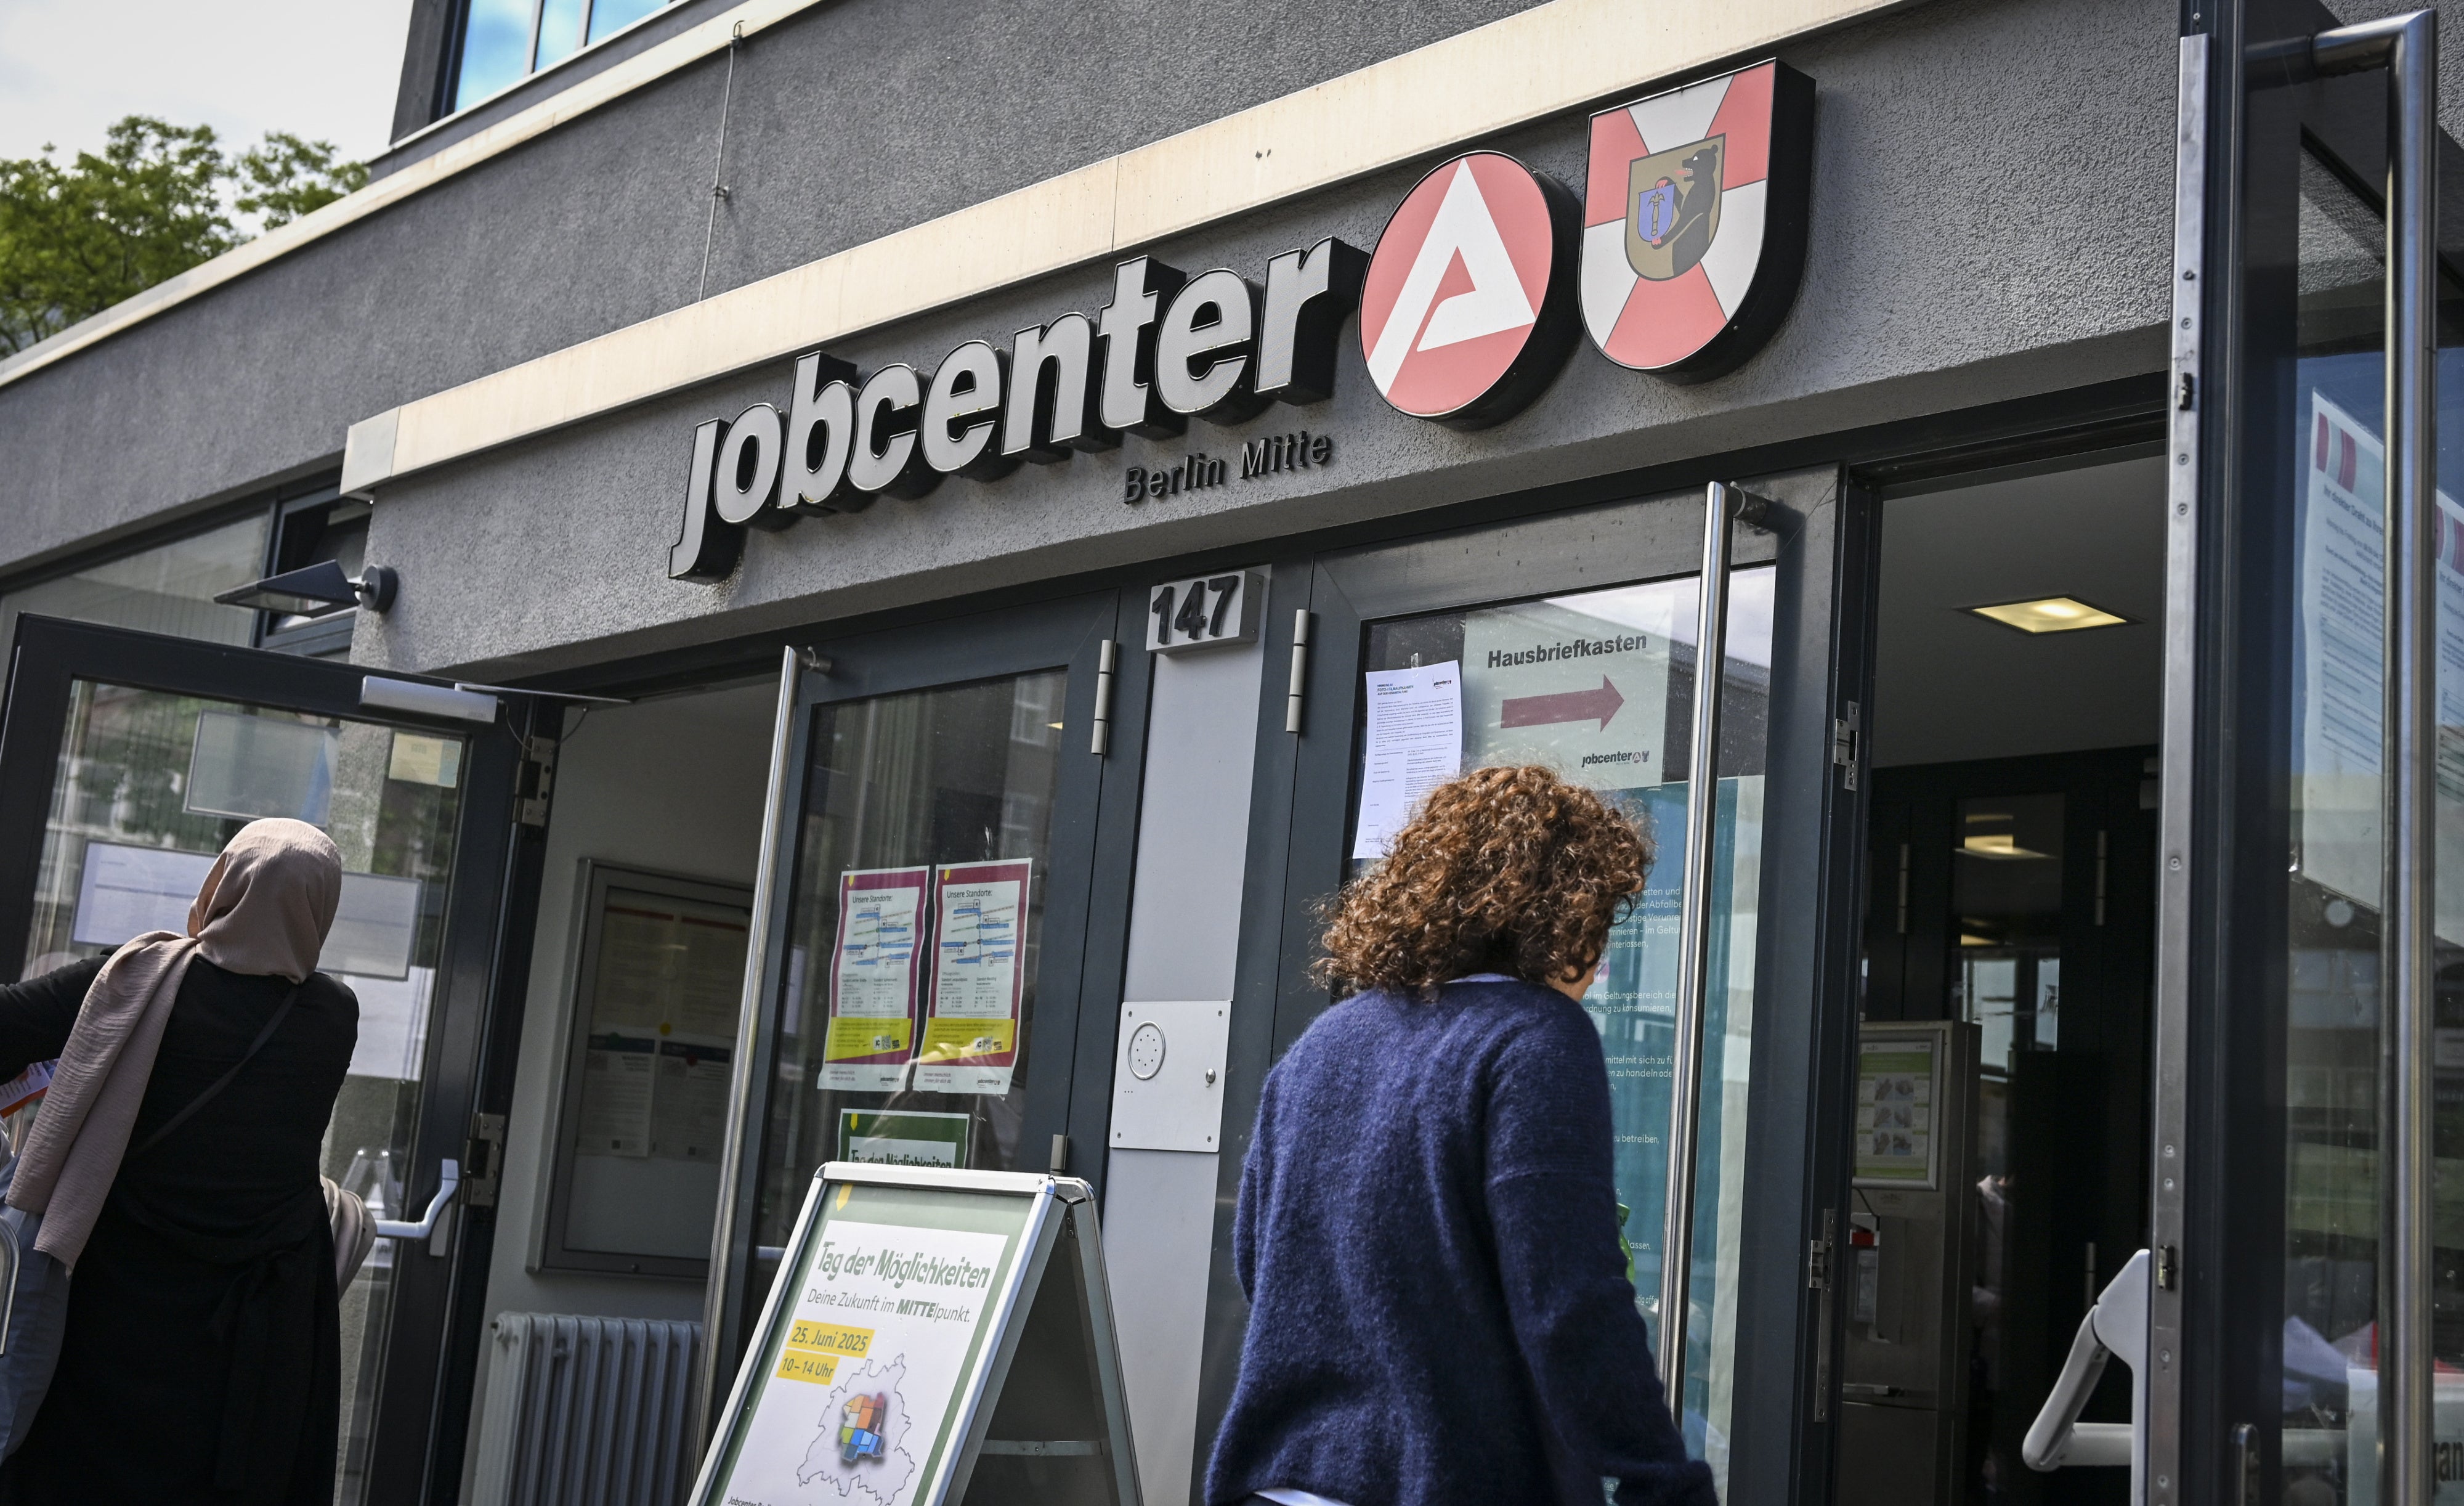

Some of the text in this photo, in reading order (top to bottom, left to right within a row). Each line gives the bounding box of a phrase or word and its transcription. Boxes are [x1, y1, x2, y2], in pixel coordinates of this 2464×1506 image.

[1124, 430, 1332, 504] Berlin Mitte
[1152, 575, 1239, 645] 147
[1488, 633, 1647, 668] Hausbriefkasten
[1581, 751, 1632, 768] jobcenter
[947, 890, 965, 898] Unsere
[1642, 886, 1680, 896] etten und
[852, 896, 869, 904] Unsere
[1636, 901, 1648, 909] der
[1593, 991, 1602, 999] im
[1603, 990, 1663, 1001] Geltungsbereich
[1622, 1003, 1671, 1013] konsumieren,
[1626, 1055, 1637, 1064] mit
[1639, 1055, 1655, 1064] sich
[1626, 1068, 1658, 1077] handeln
[1621, 1133, 1660, 1144] betreiben,
[817, 1241, 991, 1289] Tag der Möglichkeiten
[807, 1288, 970, 1323] Deine Zukunft im MITTElpunkt.
[791, 1326, 869, 1353] 25. Juni 2025
[782, 1357, 794, 1372] 10
[802, 1361, 814, 1375] 14
[815, 1362, 834, 1378] Uhr
